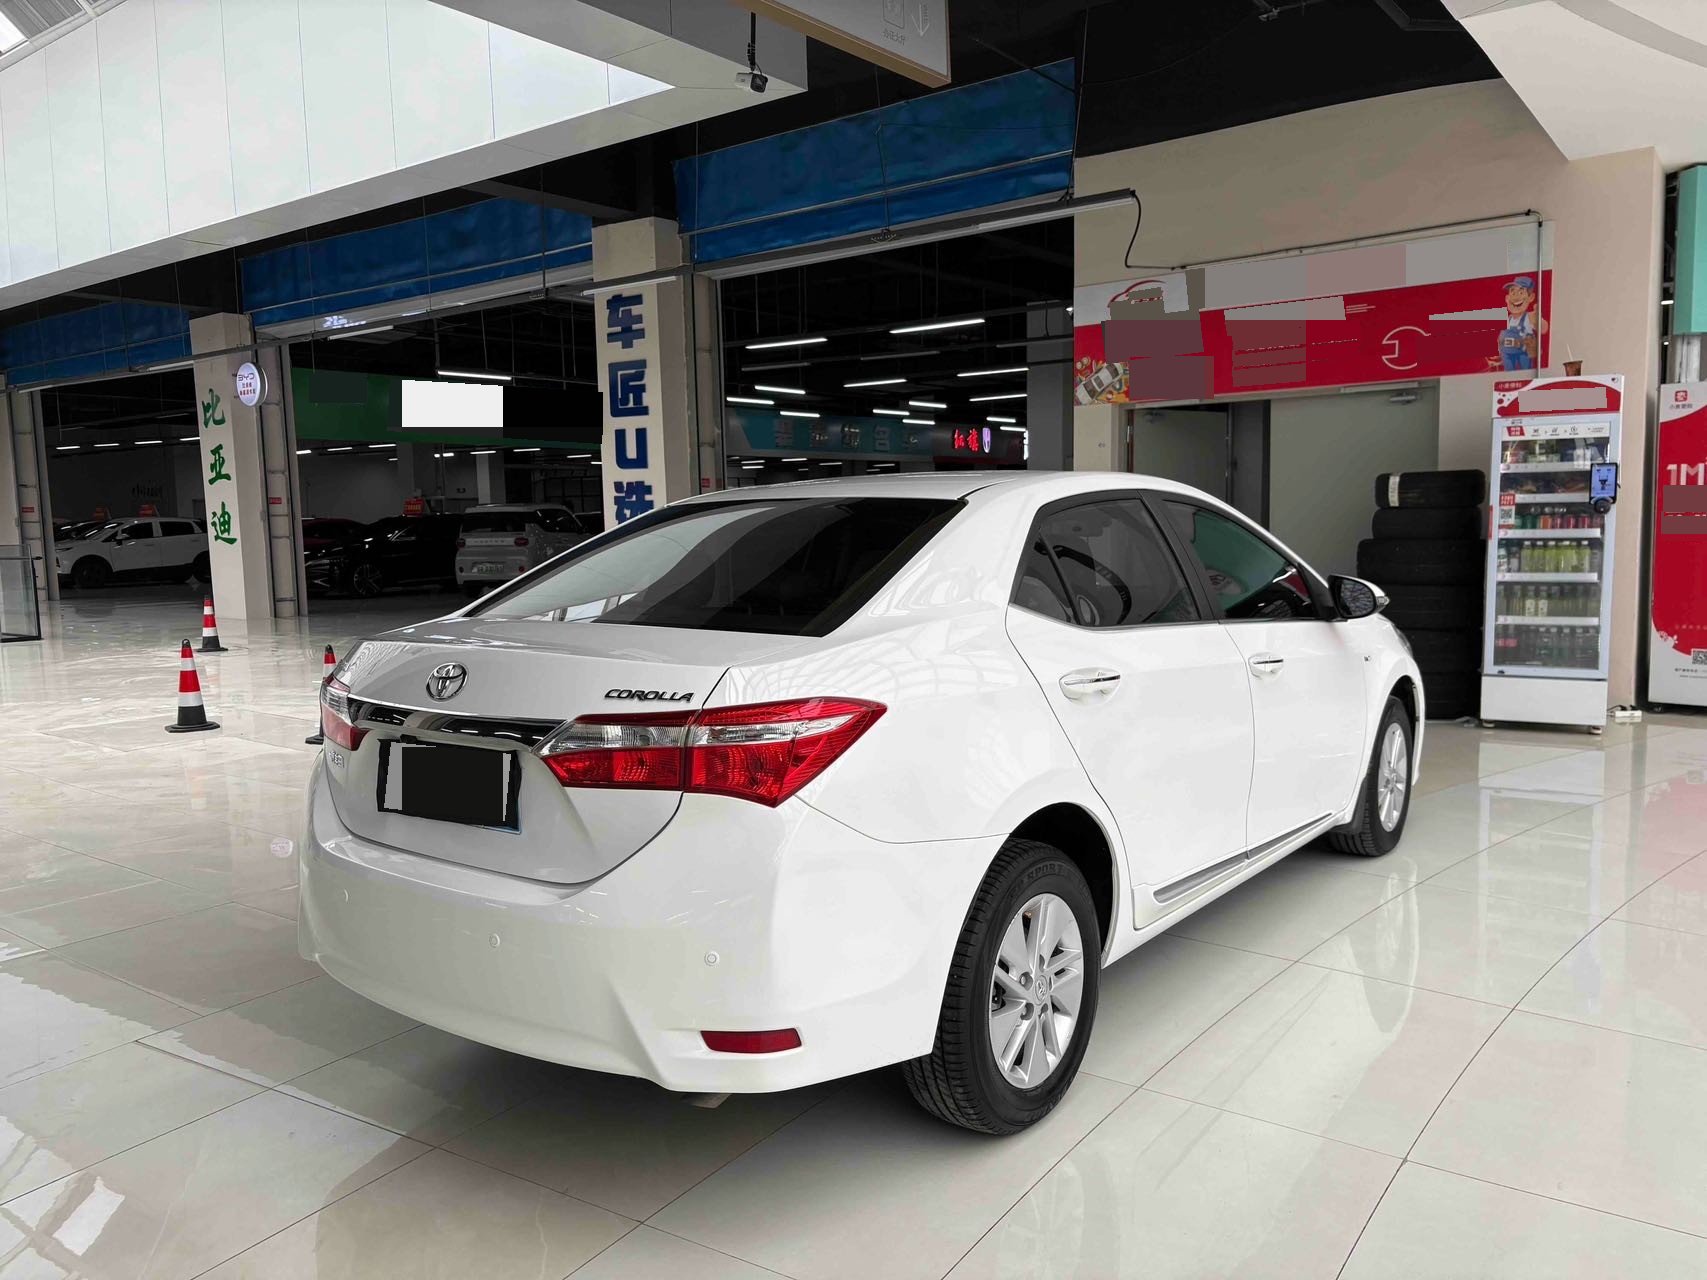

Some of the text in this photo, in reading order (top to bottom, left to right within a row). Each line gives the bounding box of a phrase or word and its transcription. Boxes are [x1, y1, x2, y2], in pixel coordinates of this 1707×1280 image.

[238, 372, 255, 381] BYD
[954, 428, 980, 452] 红旗
[201, 388, 237, 546] 比亚迪
[604, 688, 694, 702] COROLLA
